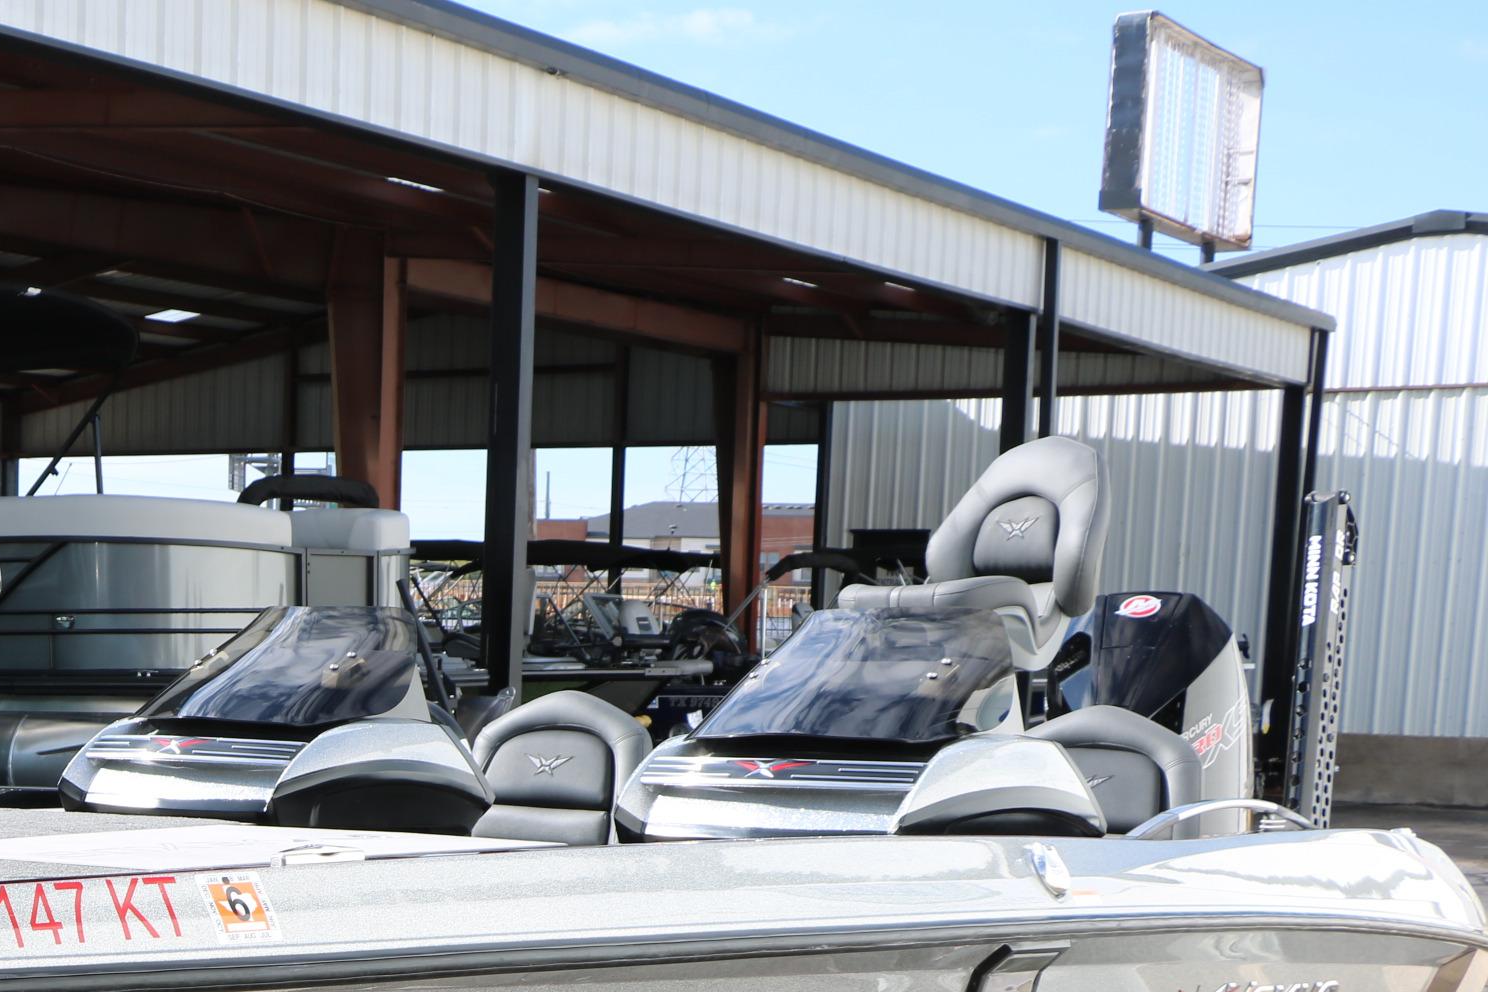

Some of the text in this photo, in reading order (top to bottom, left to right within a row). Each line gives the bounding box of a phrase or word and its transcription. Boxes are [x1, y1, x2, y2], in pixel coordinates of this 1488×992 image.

[1302, 535, 1322, 626] MINN KOTA
[105, 876, 182, 940] KT
[226, 886, 251, 922] 6
